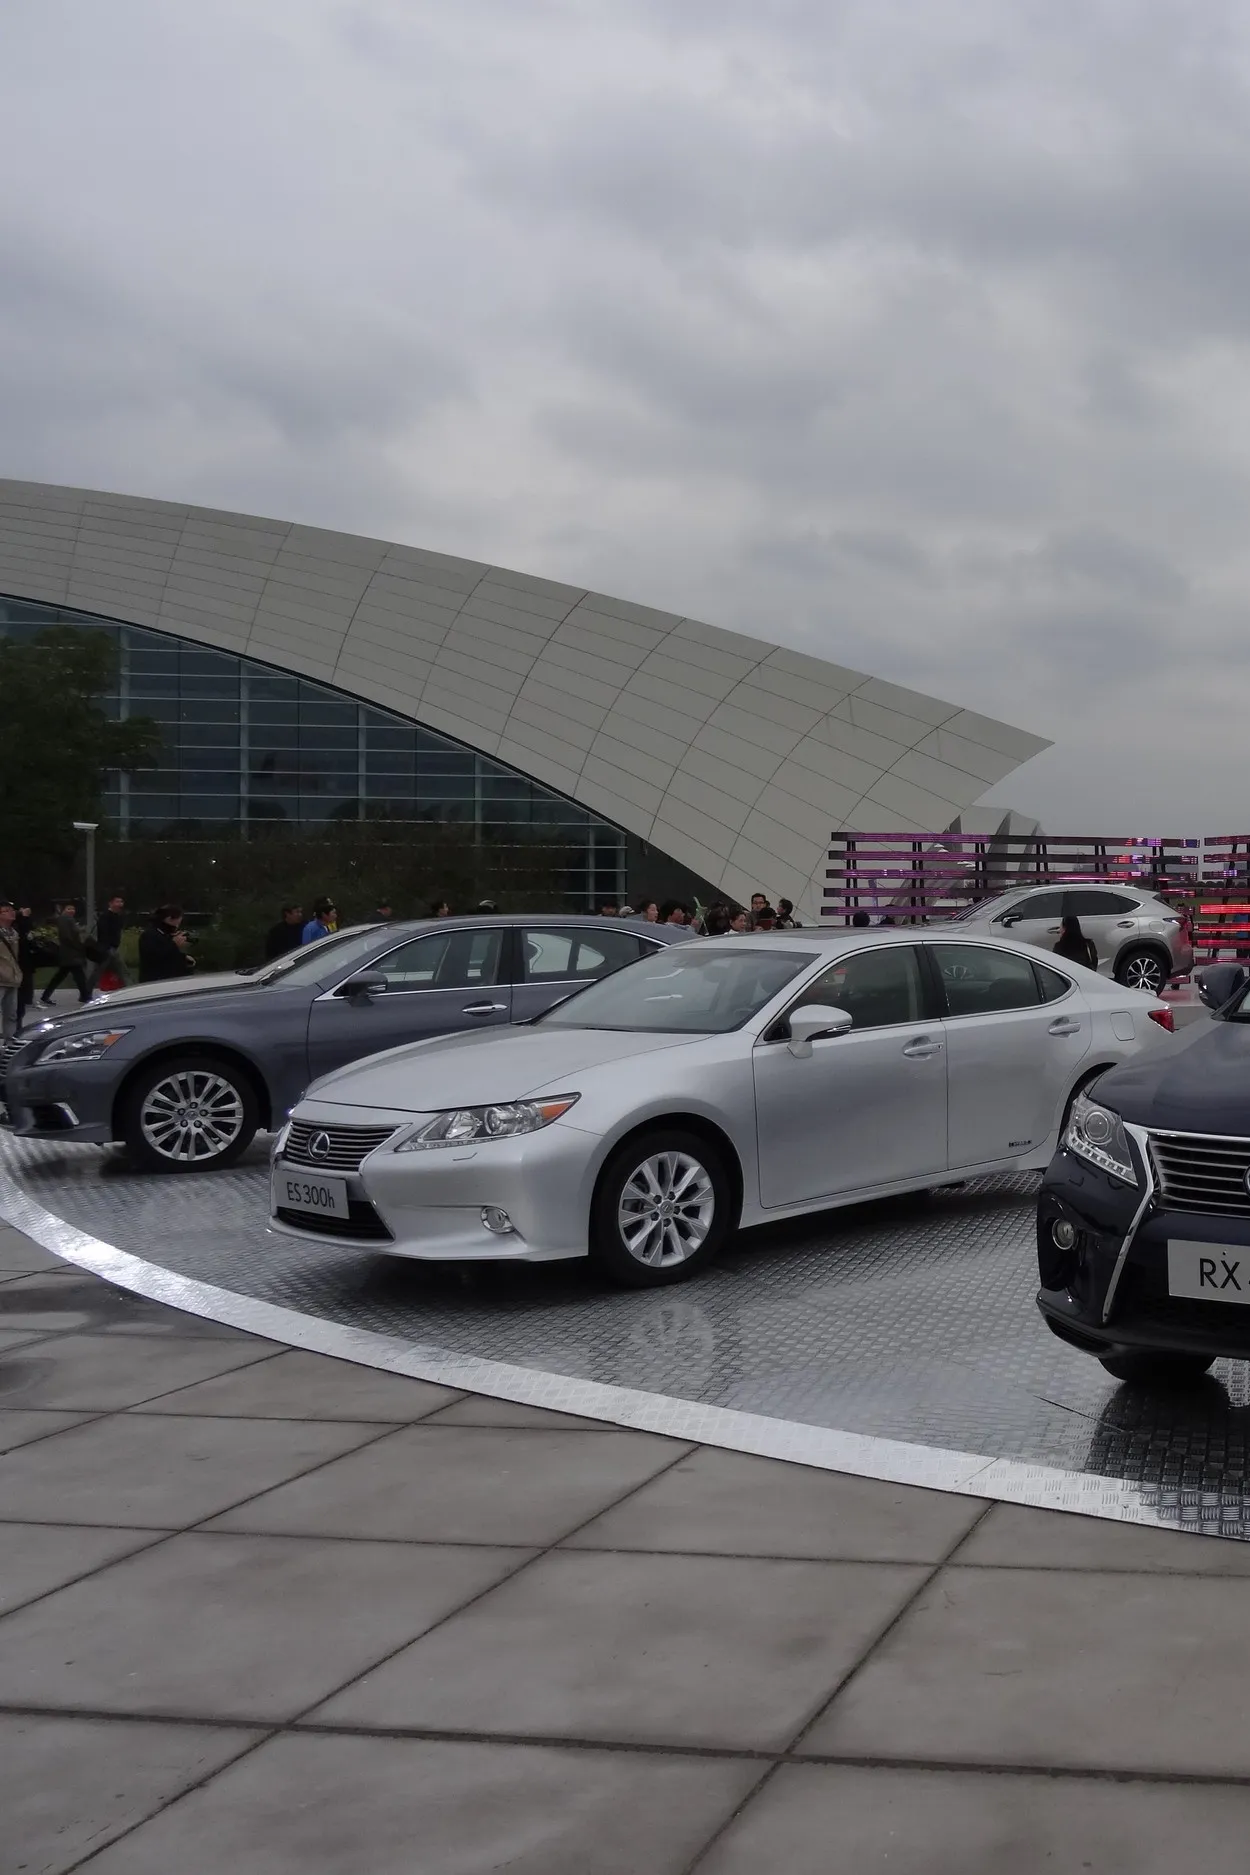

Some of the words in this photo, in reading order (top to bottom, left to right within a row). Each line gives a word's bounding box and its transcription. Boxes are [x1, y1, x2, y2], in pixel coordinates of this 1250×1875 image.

[286, 1181, 302, 1202] ES
[302, 1184, 335, 1209] 300h
[1199, 1257, 1242, 1291] RX
